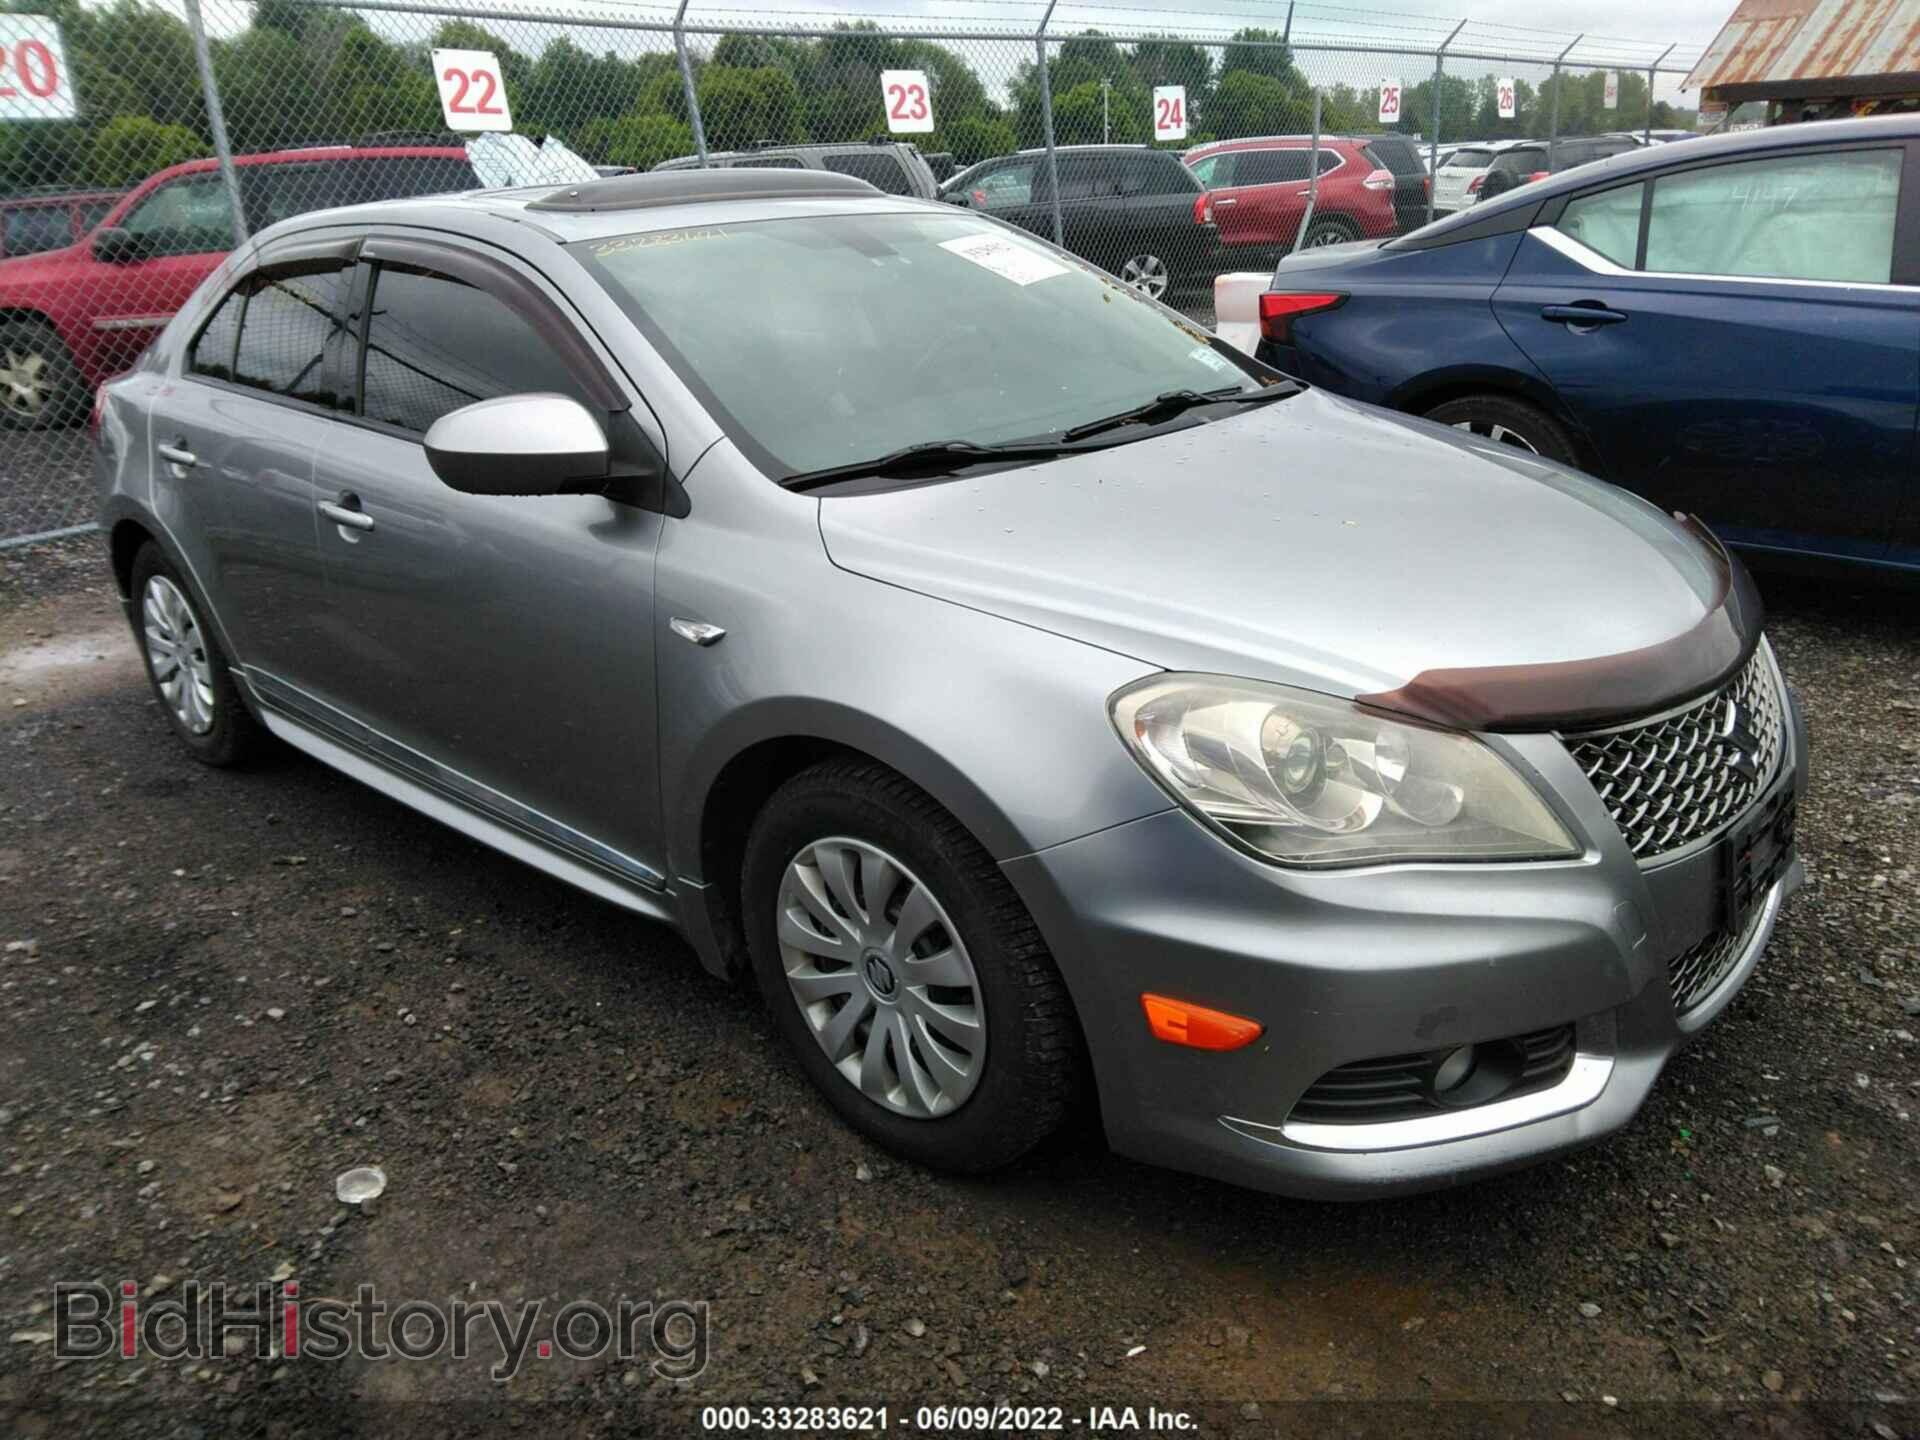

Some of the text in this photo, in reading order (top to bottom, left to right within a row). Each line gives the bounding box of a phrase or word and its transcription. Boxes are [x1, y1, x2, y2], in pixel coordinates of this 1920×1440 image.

[443, 67, 503, 114] 22
[888, 83, 928, 120] 23
[1381, 87, 1399, 113] 25
[1500, 86, 1513, 110] 26
[1157, 98, 1184, 130] 24
